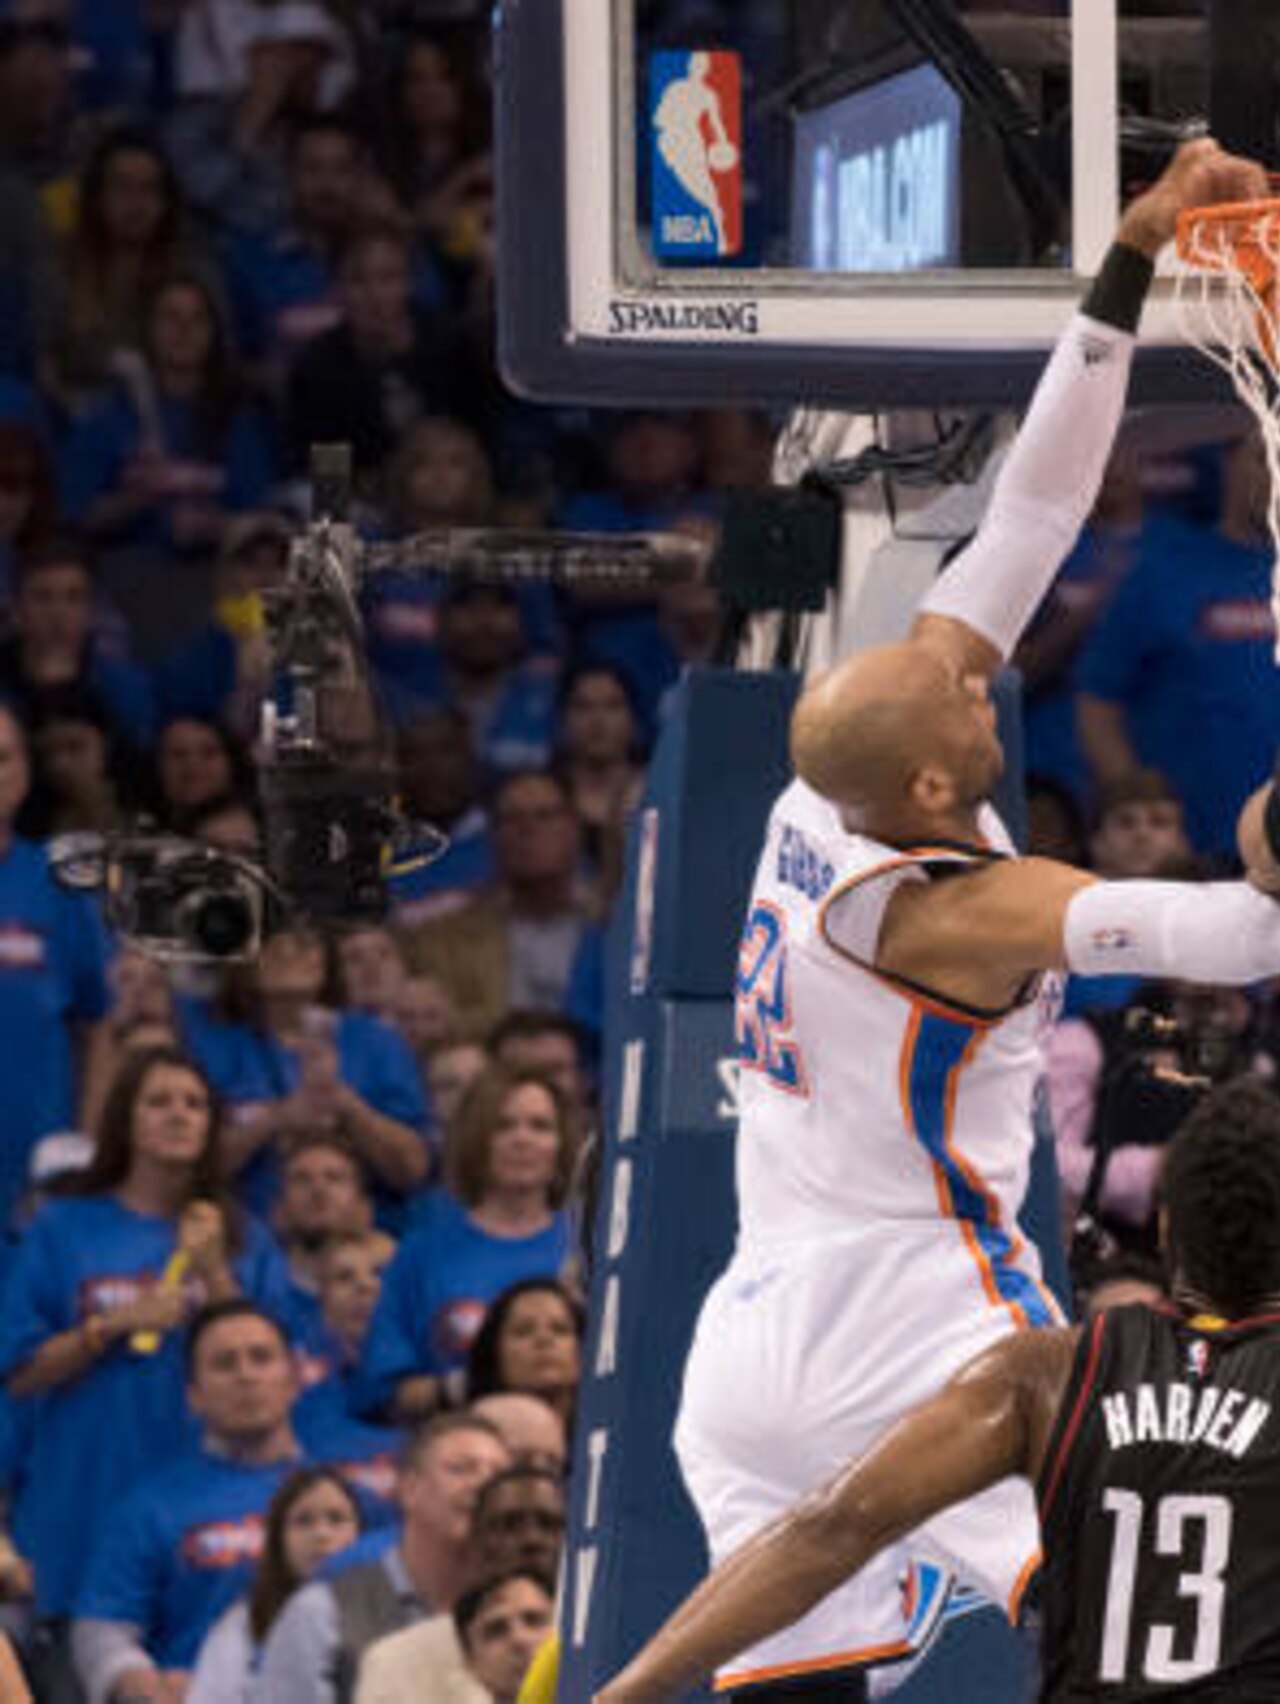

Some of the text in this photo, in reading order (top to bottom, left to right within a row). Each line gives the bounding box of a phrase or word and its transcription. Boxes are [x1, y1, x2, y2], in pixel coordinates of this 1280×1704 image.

[609, 301, 758, 334] SPALDING
[1102, 1382, 1271, 1460] HARDEN
[1098, 1487, 1233, 1684] 13
